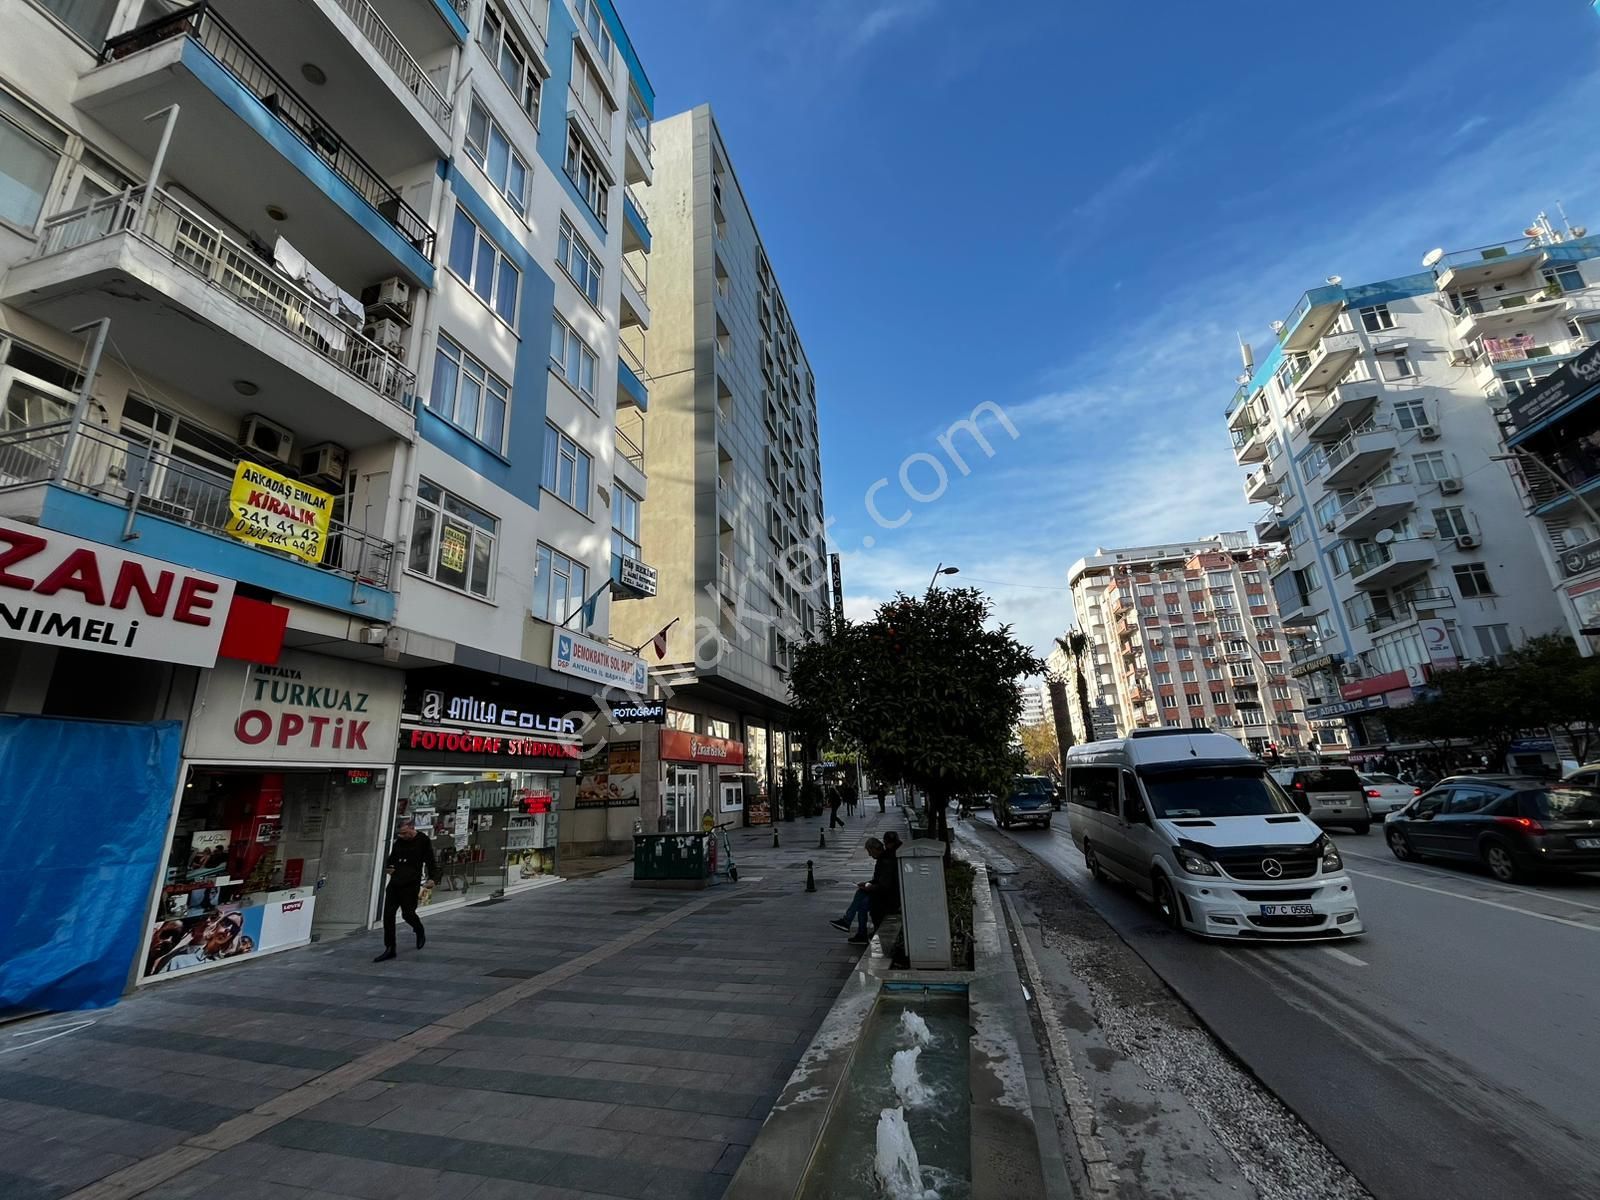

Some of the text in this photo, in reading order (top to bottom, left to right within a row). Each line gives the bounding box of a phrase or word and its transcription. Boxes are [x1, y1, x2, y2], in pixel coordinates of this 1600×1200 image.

[242, 469, 327, 510] ARKADAŞ EMLAK
[247, 490, 316, 526] KİRALIK
[238, 507, 319, 543] 241 41 42
[245, 524, 268, 540] 533
[267, 532, 288, 546] 541
[557, 659, 570, 668] DSP
[572, 662, 598, 675] ANTALYA
[573, 643, 610, 668] DEMOKRATİK
[610, 656, 620, 671] SOL
[255, 664, 302, 679] ANTALYA
[447, 696, 575, 733] ATİLLA COLOR
[410, 729, 502, 754] FOTOĞRAF
[1266, 905, 1311, 915] 07 C 0556
